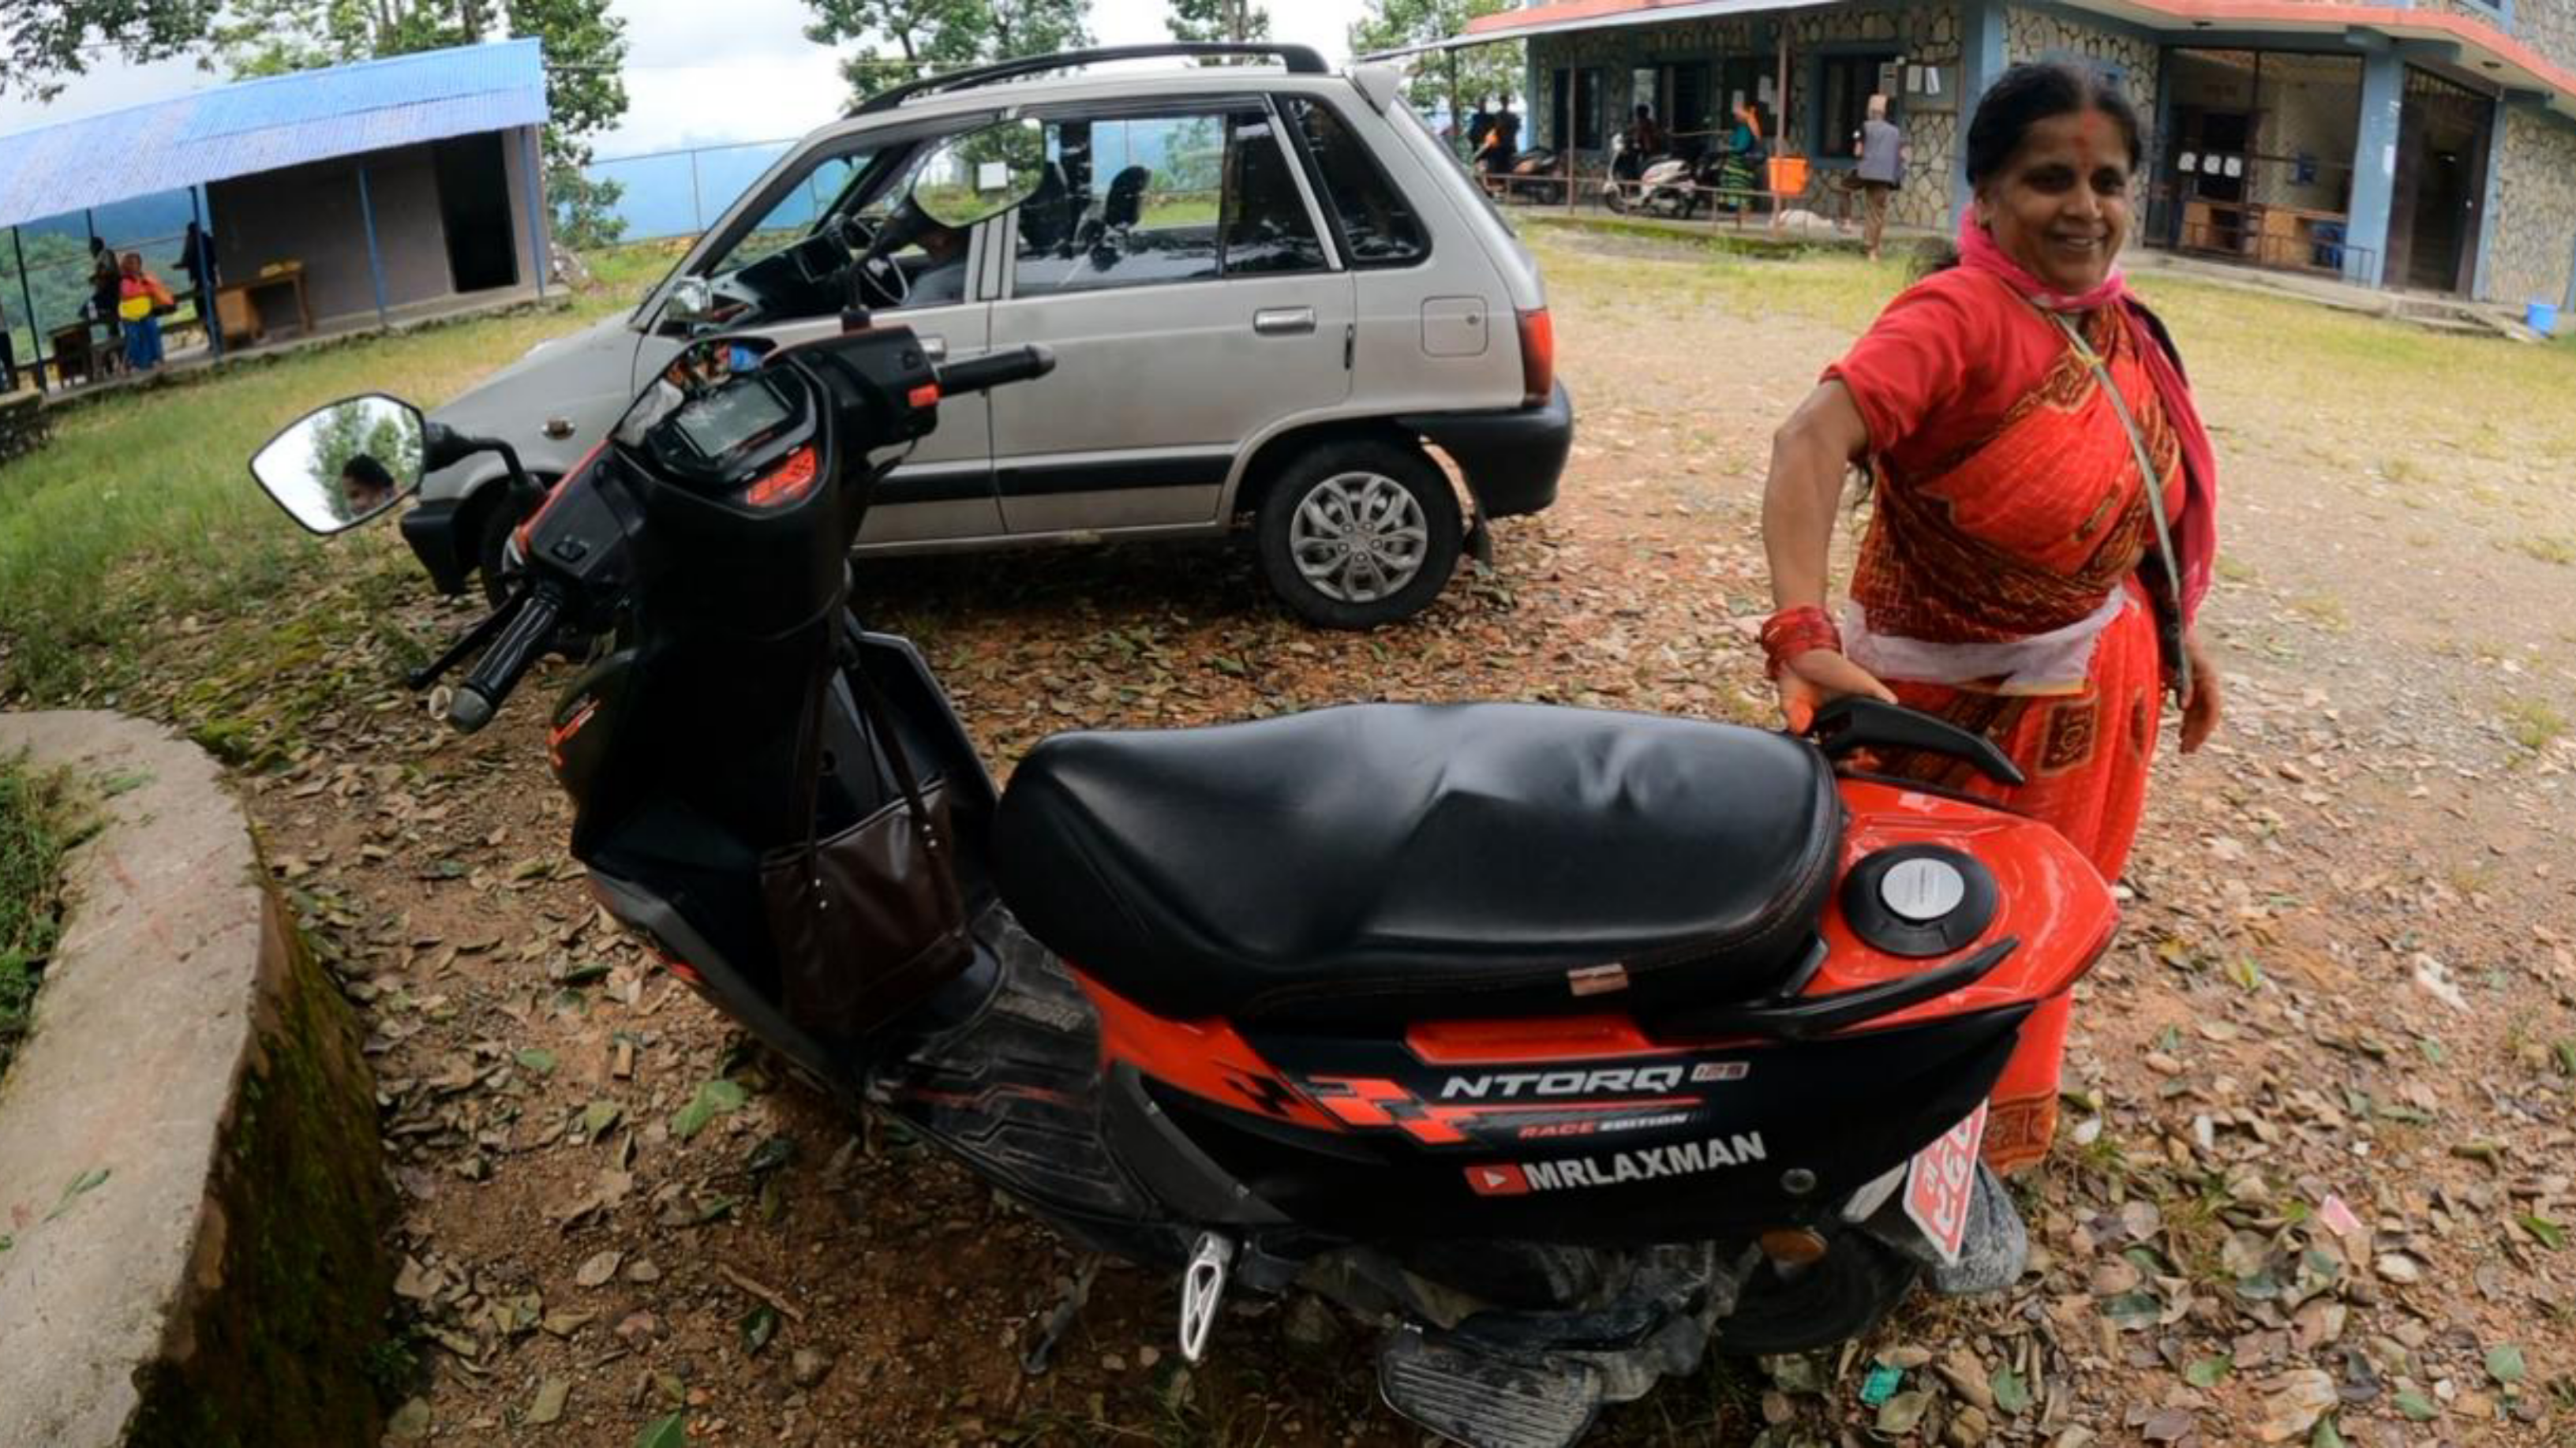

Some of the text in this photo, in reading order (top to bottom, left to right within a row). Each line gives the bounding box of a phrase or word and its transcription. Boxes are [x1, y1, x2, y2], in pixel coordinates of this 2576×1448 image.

[1441, 1066, 1683, 1098] NTORQ
[1518, 1113, 1688, 1139] RACE EDITION
[1522, 1132, 1767, 1191] MRLAXMAN
